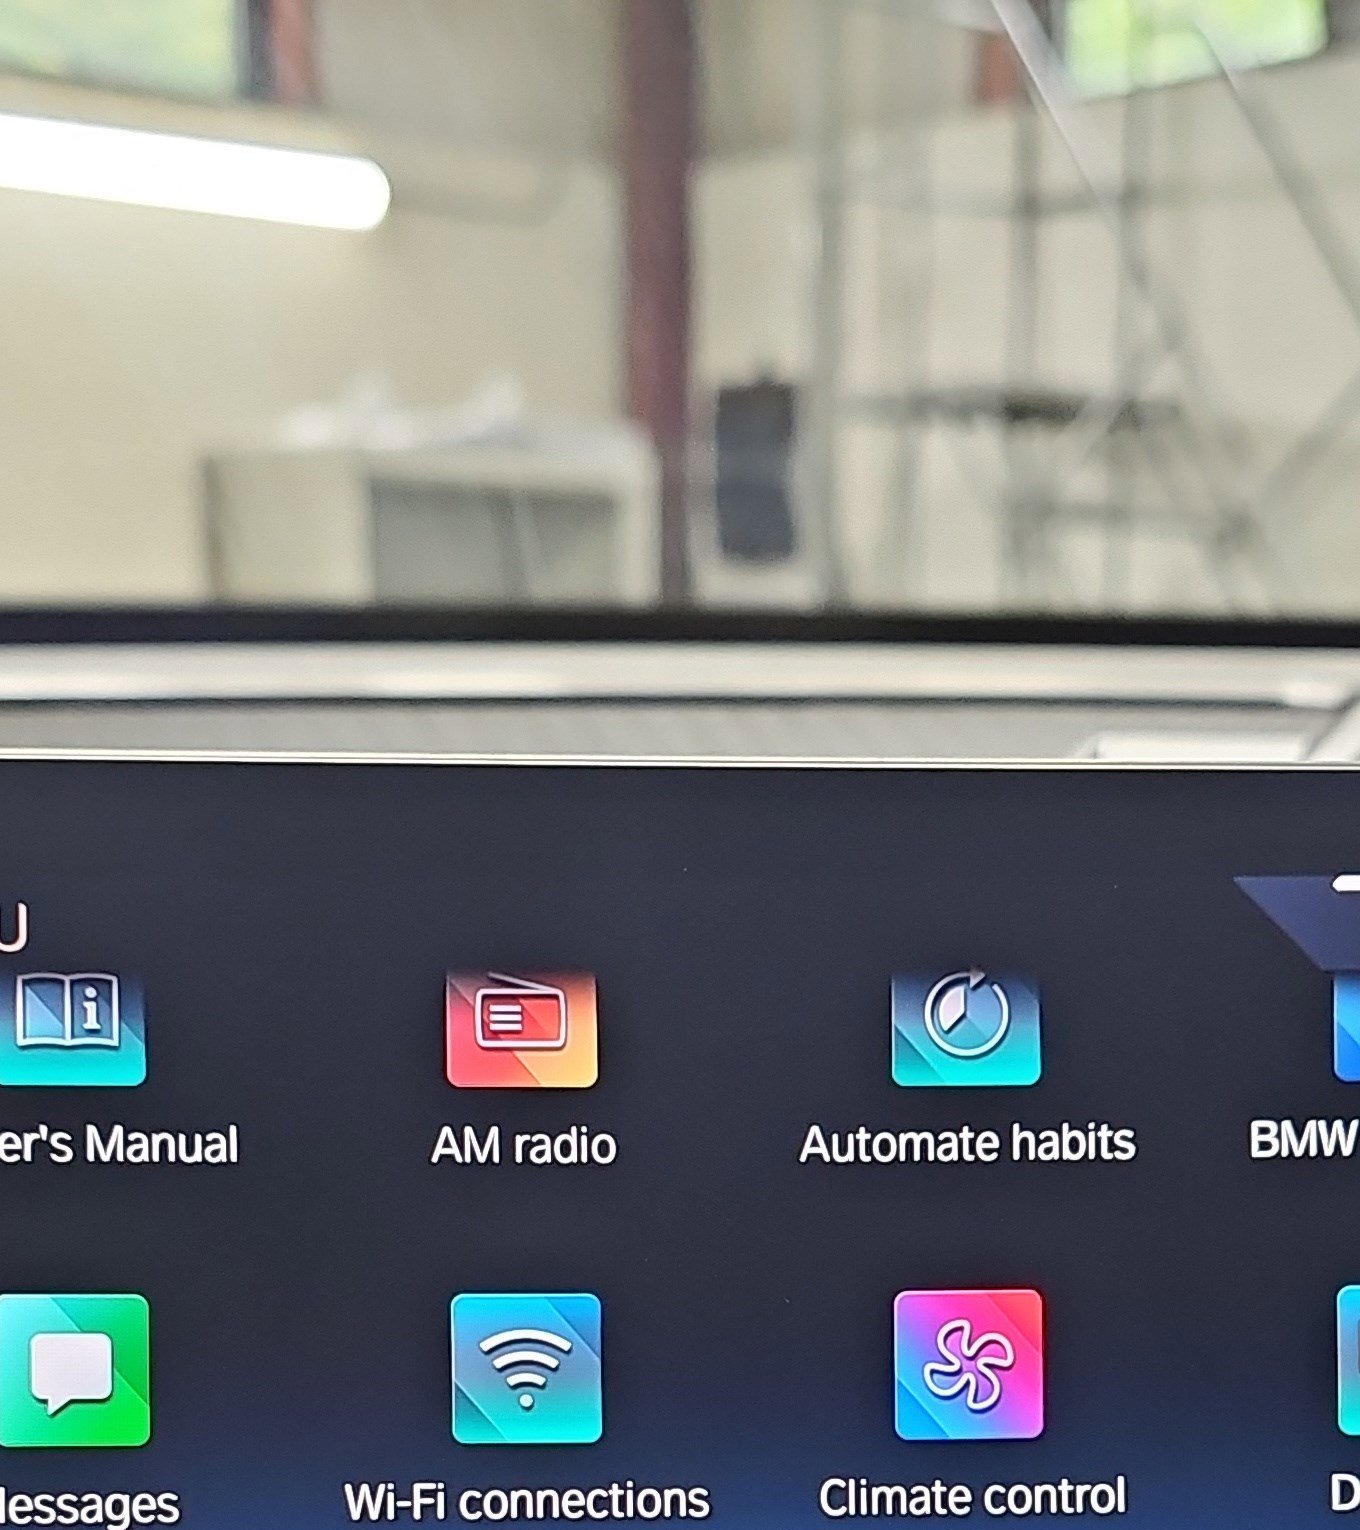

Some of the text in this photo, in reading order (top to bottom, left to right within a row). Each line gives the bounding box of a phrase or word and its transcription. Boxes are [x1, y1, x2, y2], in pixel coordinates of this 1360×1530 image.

[86, 1124, 238, 1164] Manual
[431, 1125, 617, 1164] AM radio
[799, 1121, 1136, 1163] Automate habits
[1250, 1119, 1359, 1158] BMW
[344, 1480, 710, 1521] Wi-Fi connections
[820, 1475, 1126, 1517] Climate control
